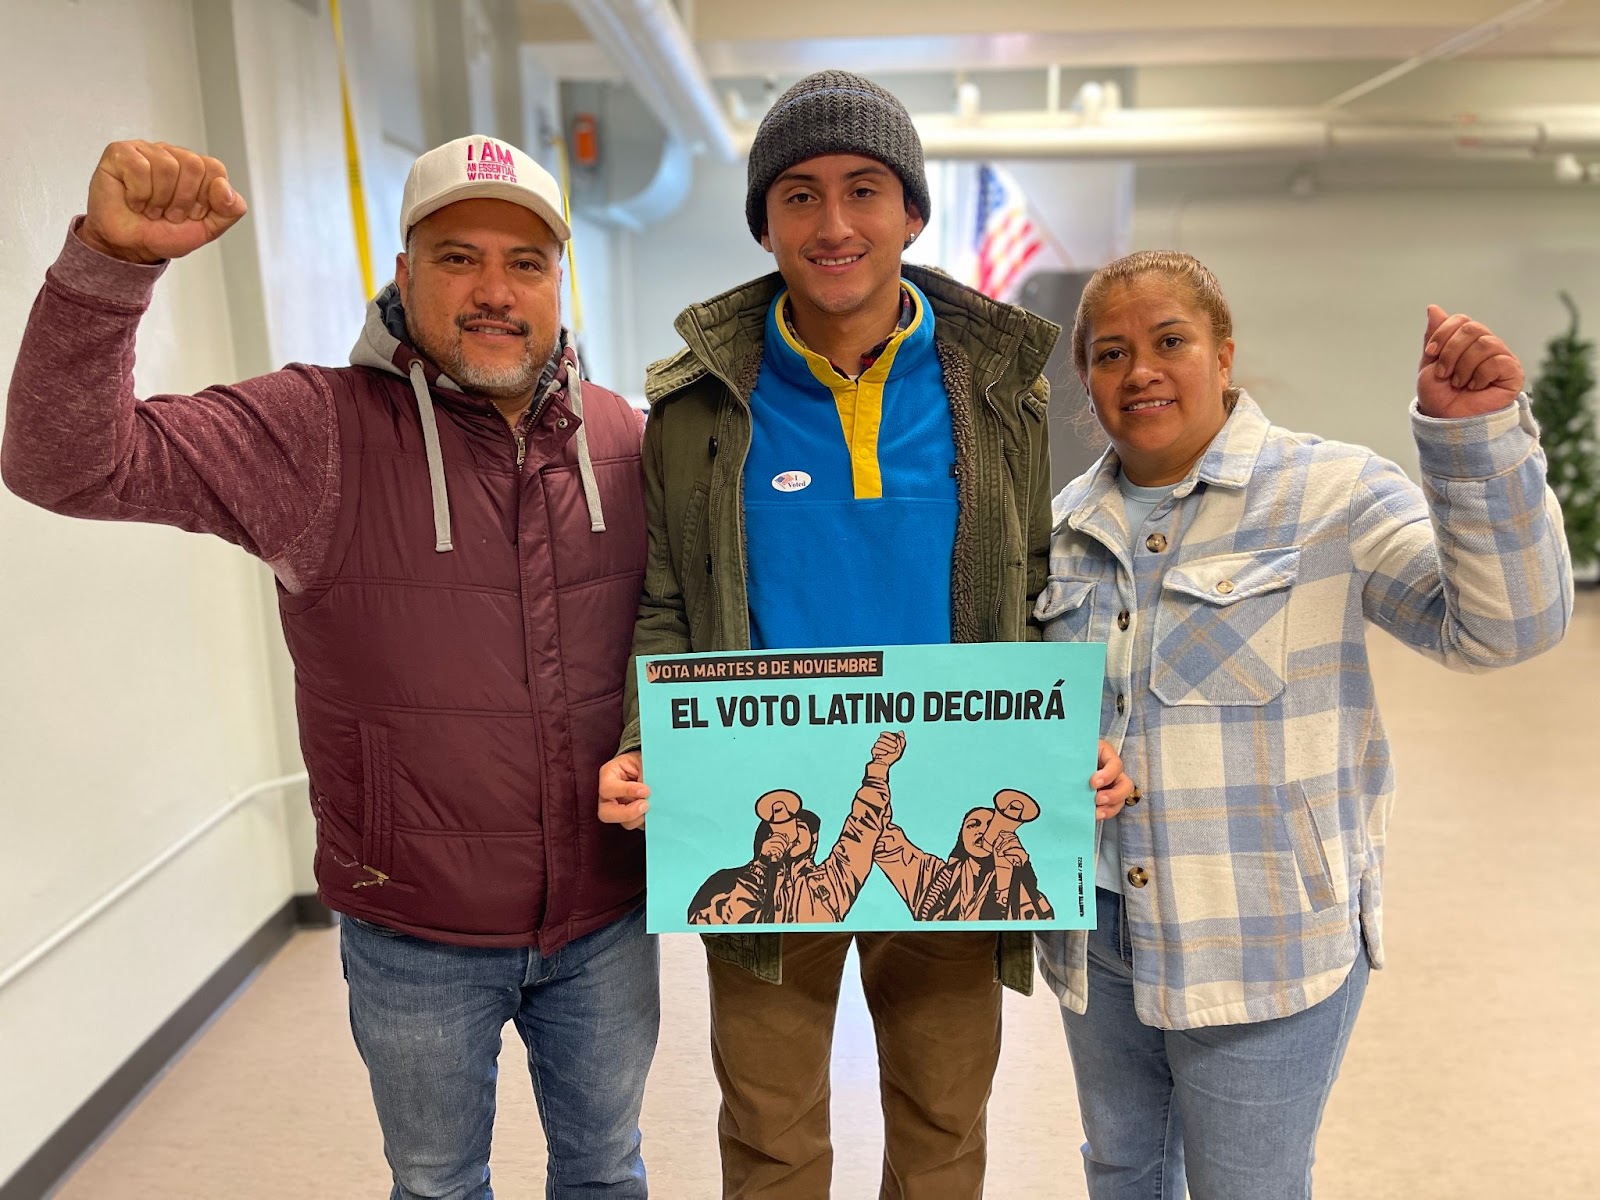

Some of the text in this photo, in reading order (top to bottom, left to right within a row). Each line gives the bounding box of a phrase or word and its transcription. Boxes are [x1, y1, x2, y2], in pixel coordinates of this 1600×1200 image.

[467, 141, 515, 166] I AM
[467, 163, 516, 178] AN ESSENTIAL
[787, 480, 806, 488] Voted
[648, 657, 878, 680] VOTA MARTES 8 DE NOVIEMBRE
[671, 678, 1066, 729] EL VOTO LATINO DECIDIRÁ
